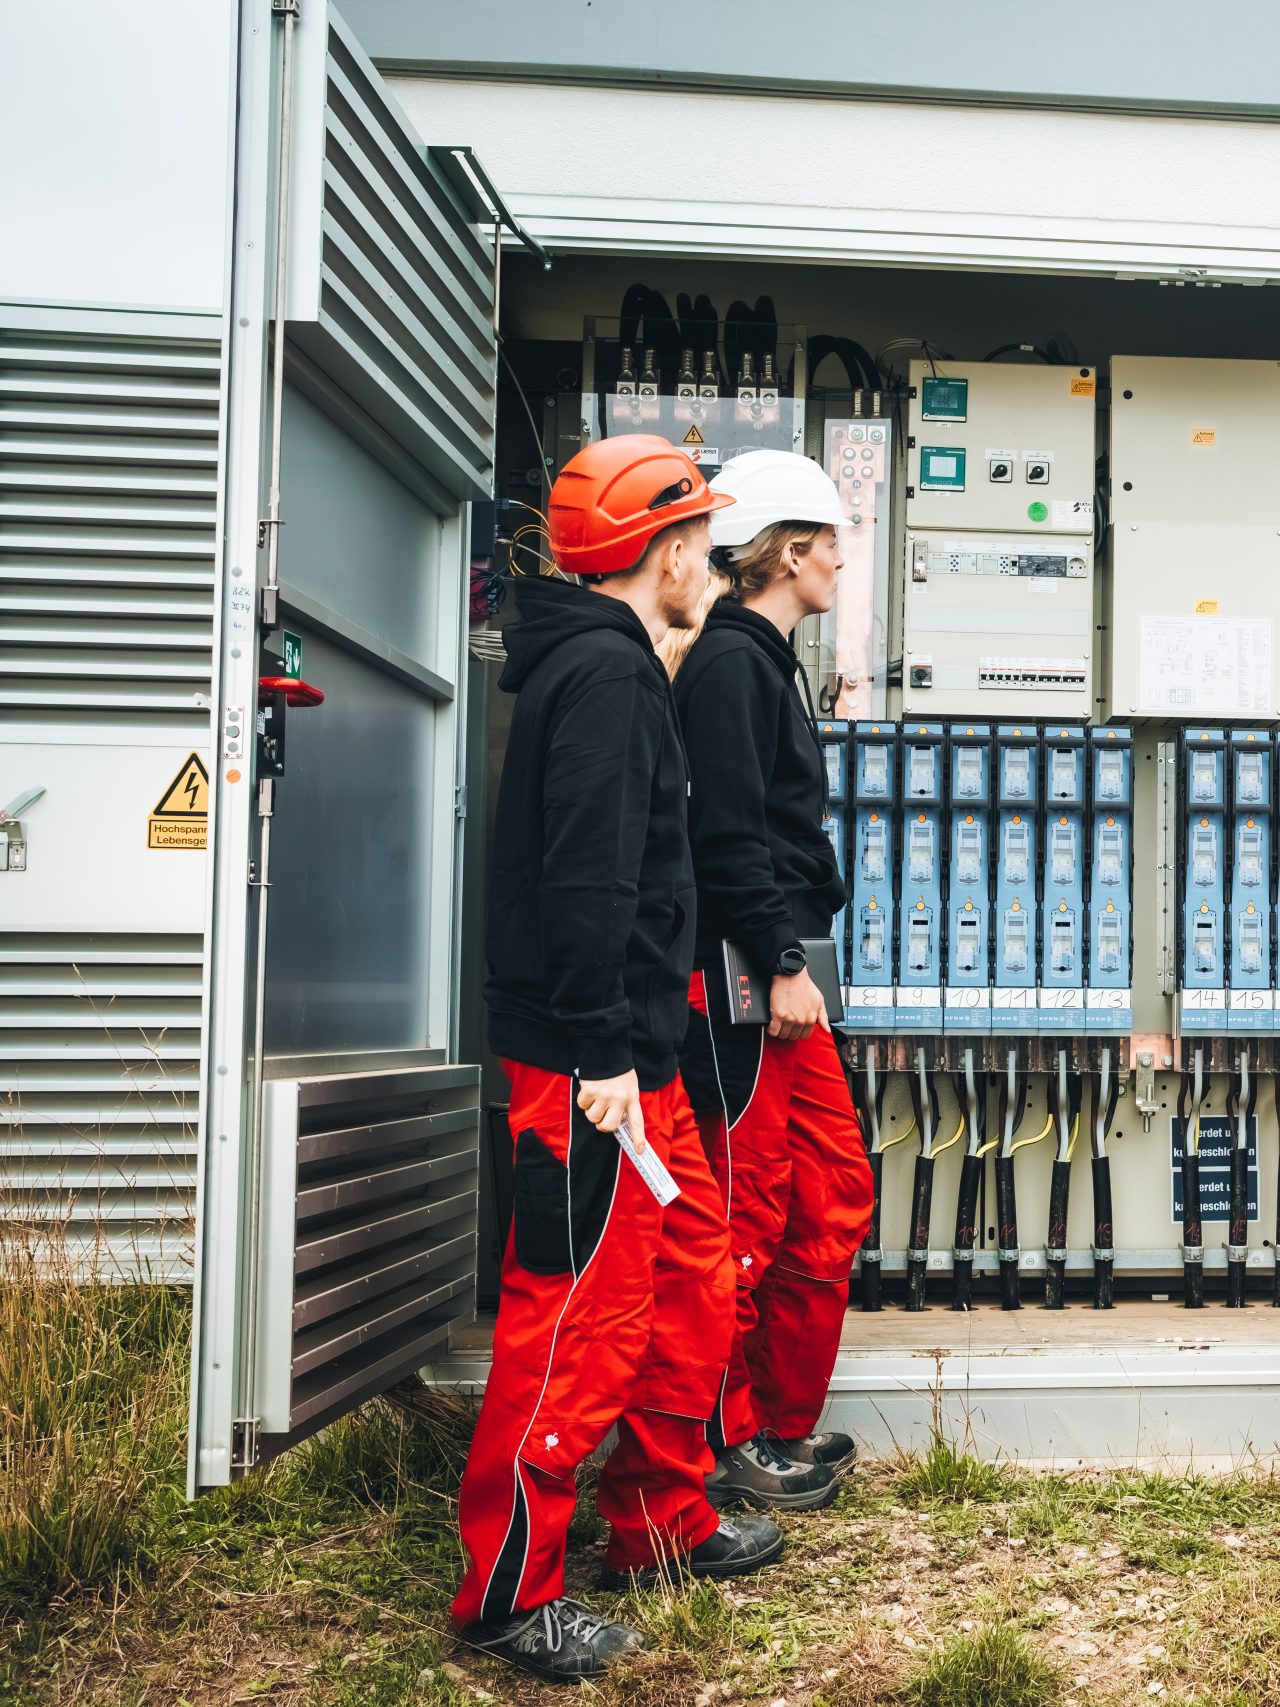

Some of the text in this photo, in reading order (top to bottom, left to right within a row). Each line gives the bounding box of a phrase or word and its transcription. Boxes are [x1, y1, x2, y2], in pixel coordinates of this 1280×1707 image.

[862, 987, 878, 1005] 8
[952, 988, 981, 1008] 10
[999, 989, 1027, 1008] 11
[1047, 989, 1076, 1008] 12
[1092, 990, 1123, 1008] 13
[1191, 990, 1218, 1008] 14
[1235, 990, 1264, 1009] 15
[1198, 1127, 1222, 1138] erdet
[1199, 1181, 1224, 1192] erdet
